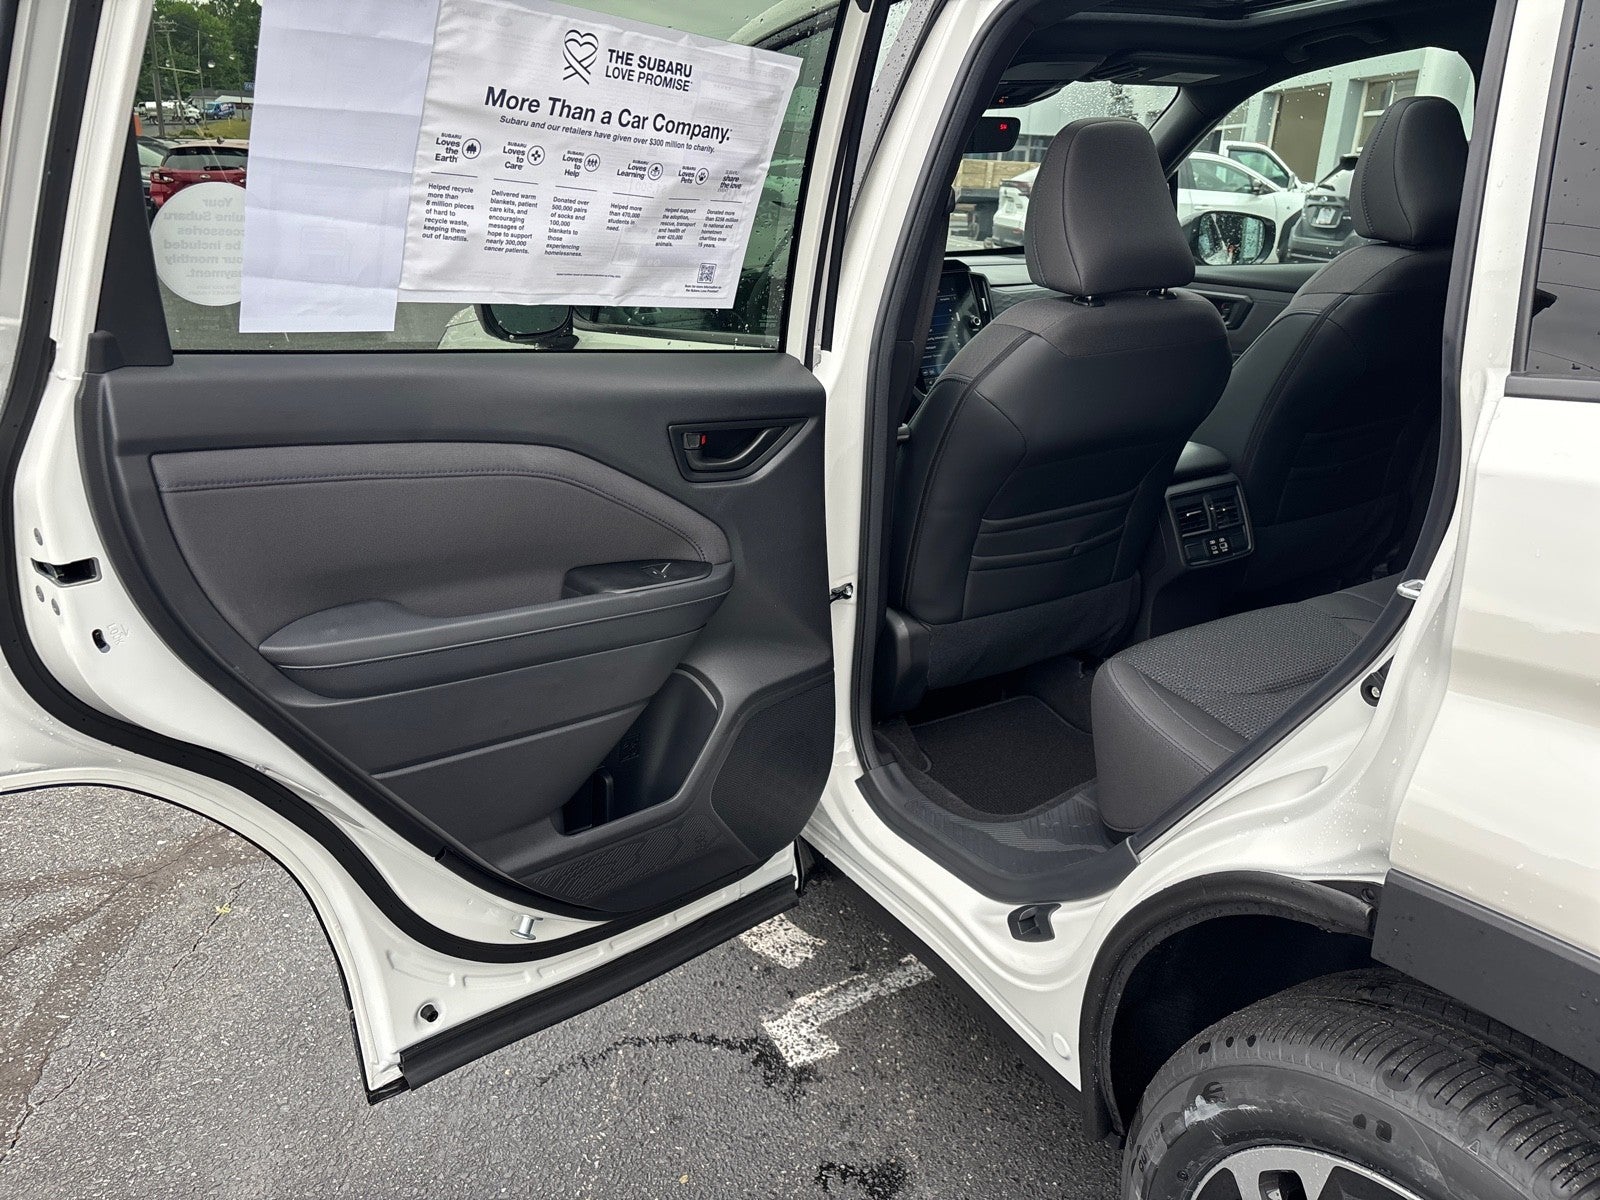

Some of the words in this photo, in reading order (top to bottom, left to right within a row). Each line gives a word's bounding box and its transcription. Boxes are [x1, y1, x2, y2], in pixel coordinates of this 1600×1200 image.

[607, 49, 634, 66] THE
[637, 55, 692, 78] SUBARU
[605, 65, 634, 82] LOVE
[637, 74, 690, 92] PROMISE
[484, 86, 540, 113] More
[548, 97, 596, 122] Than
[601, 110, 612, 125] a
[618, 109, 648, 130] Car
[653, 114, 730, 144] Company.
[500, 116, 528, 127] Subaru
[530, 120, 546, 130] and
[547, 124, 560, 132] our
[562, 125, 592, 137] retailers
[594, 129, 610, 139] have
[612, 133, 631, 144] given
[633, 136, 648, 145] over
[649, 137, 664, 147] $300
[665, 139, 685, 149] million
[694, 143, 715, 154] charity.
[436, 138, 460, 147] Loves
[445, 147, 459, 155] the
[503, 146, 525, 156] Loves
[435, 154, 457, 163] Earth
[562, 155, 582, 163] Loves
[504, 161, 523, 170] Care
[627, 163, 646, 171] Loves
[564, 169, 580, 178] Help
[617, 169, 645, 180] Learning
[428, 183, 450, 191] Helped
[452, 185, 474, 193] recycle
[492, 190, 519, 198] Delivered
[491, 198, 516, 207] blankets,
[553, 197, 576, 205] Donated
[449, 219, 469, 227] waste,
[488, 215, 525, 224] encouraging
[423, 225, 448, 233] keeping
[488, 223, 517, 231] messages
